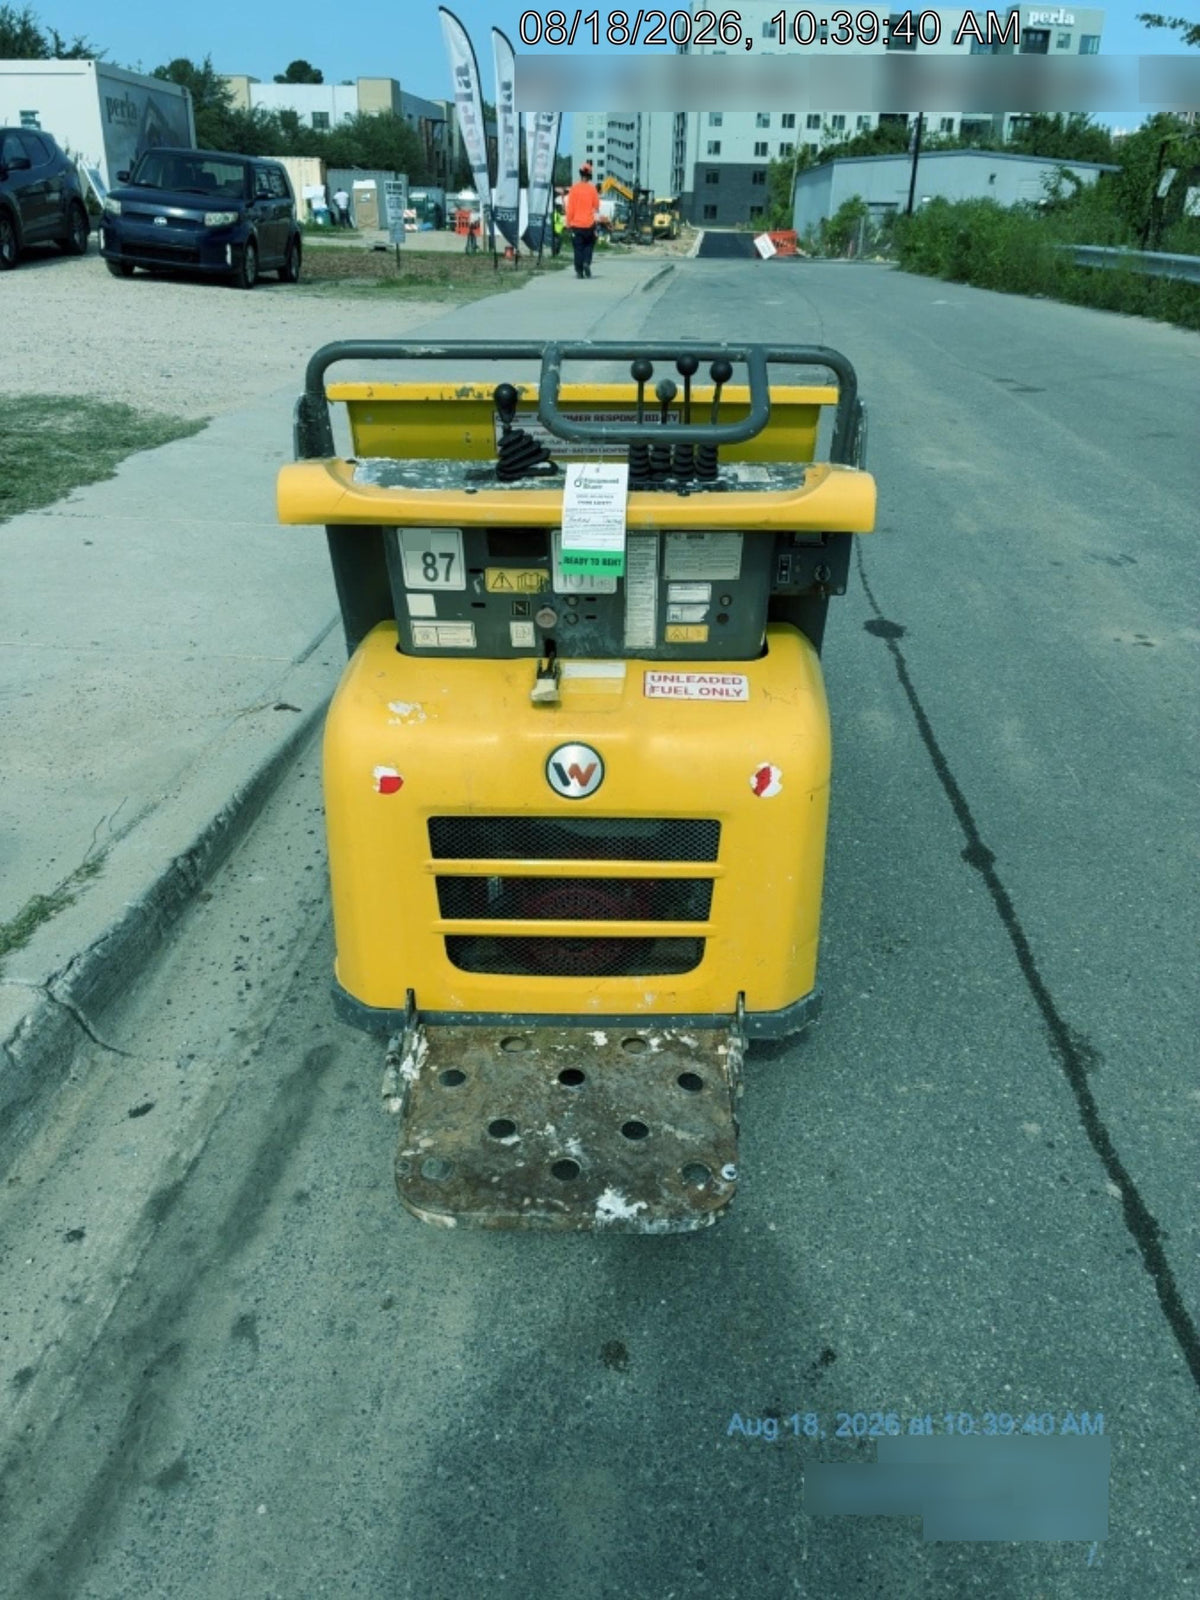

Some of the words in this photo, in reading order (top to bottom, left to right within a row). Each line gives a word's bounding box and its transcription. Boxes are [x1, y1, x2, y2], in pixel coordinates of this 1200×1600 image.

[1028, 8, 1075, 26] perla
[422, 551, 455, 582] 87
[563, 556, 588, 567] READY
[590, 557, 600, 567] TO
[601, 557, 621, 567] RENT
[650, 674, 743, 685] UNLEADED
[650, 685, 695, 696] FUEL
[698, 687, 743, 698] ONLY
